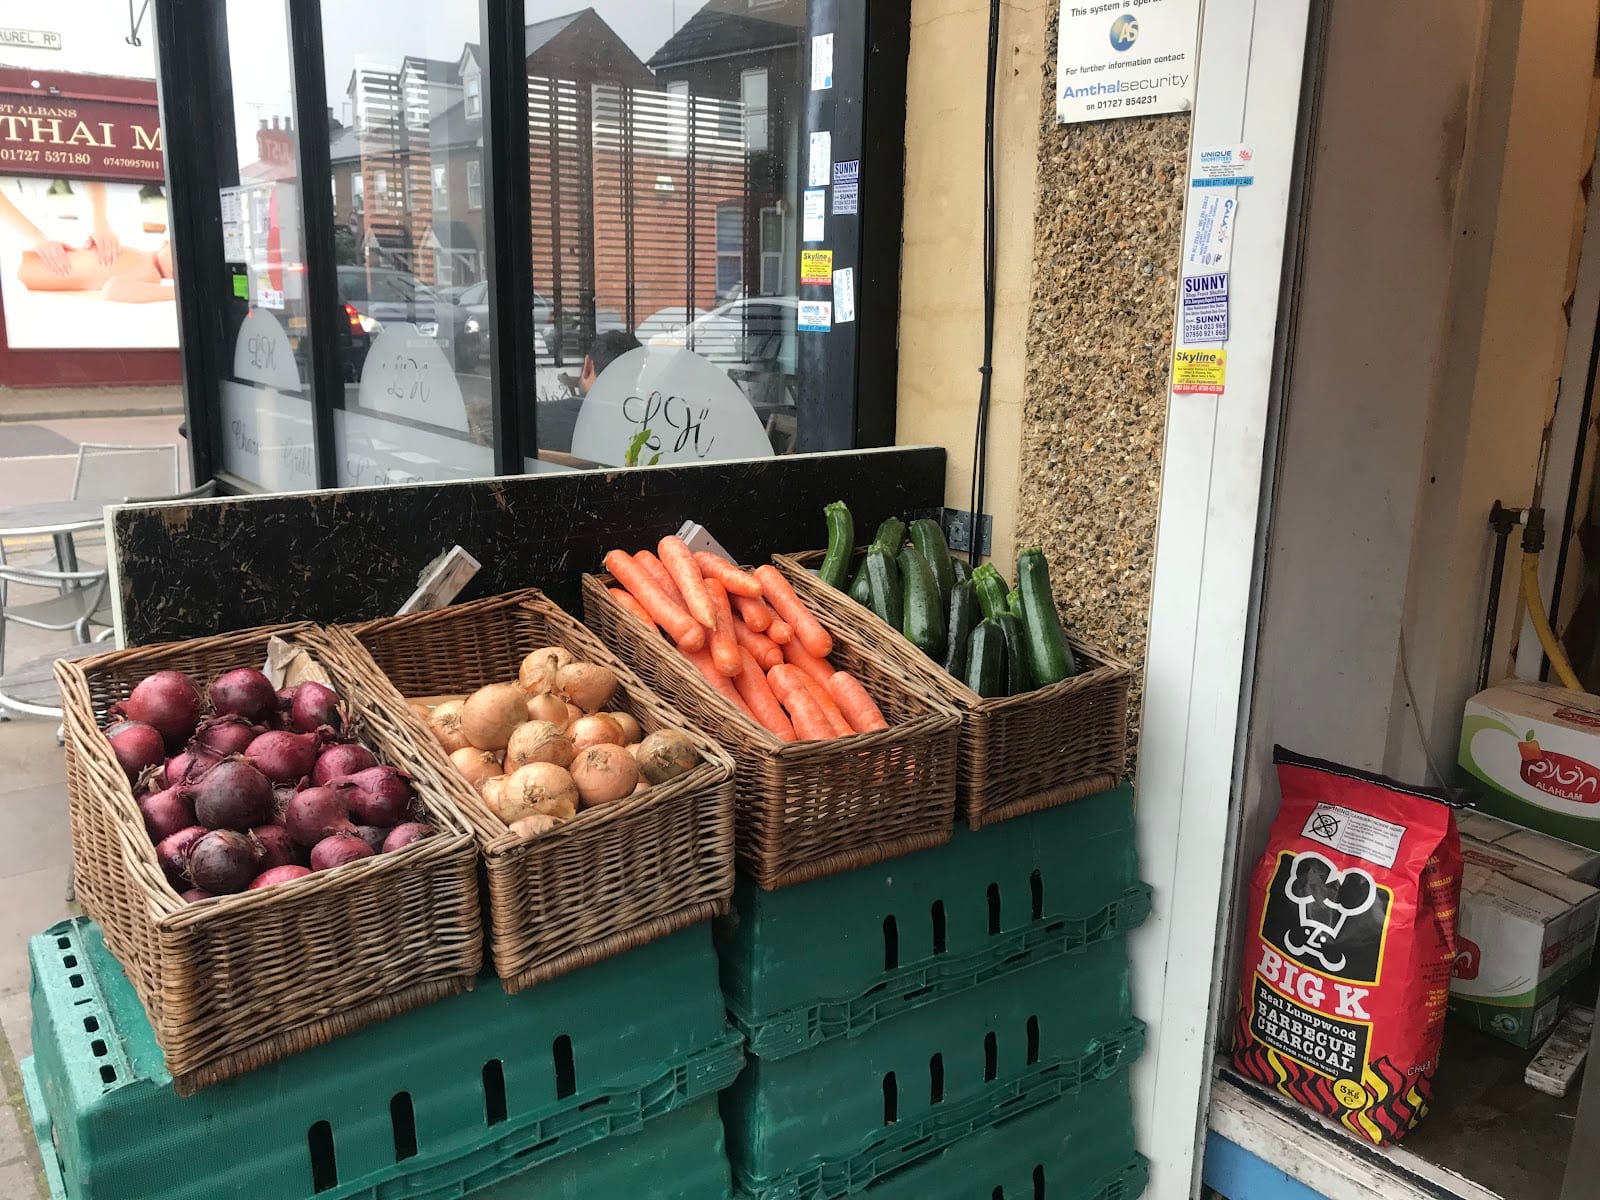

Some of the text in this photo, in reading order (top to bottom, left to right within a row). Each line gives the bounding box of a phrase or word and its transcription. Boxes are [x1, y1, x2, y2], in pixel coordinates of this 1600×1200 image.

[1071, 8, 1087, 17] This
[1090, 1, 1120, 15] system
[1123, 0, 1130, 8] is
[1119, 21, 1138, 43] AS
[1066, 53, 1185, 76] For further information contact
[1097, 99, 1123, 109] 01727
[1125, 95, 1157, 106] 854231
[17, 105, 78, 118] ALBANS
[0, 116, 117, 148] THAI
[0, 149, 40, 161] 01727
[45, 151, 91, 164] 537180
[835, 161, 857, 175] SUNNY
[803, 252, 828, 261] Skyline
[1186, 275, 1226, 293] SUNNY
[1195, 314, 1226, 323] SUNNY
[1176, 351, 1217, 363] Skyline
[1535, 781, 1583, 801] ALAHLAM
[1256, 944, 1326, 1008] BIG
[1334, 983, 1370, 1020] K
[1260, 987, 1357, 1041] Real Lumpwood
[1258, 1000, 1357, 1059] BARBECUE
[1257, 1015, 1353, 1073] CHARCOAL
[1339, 1084, 1360, 1100] 3Kg
